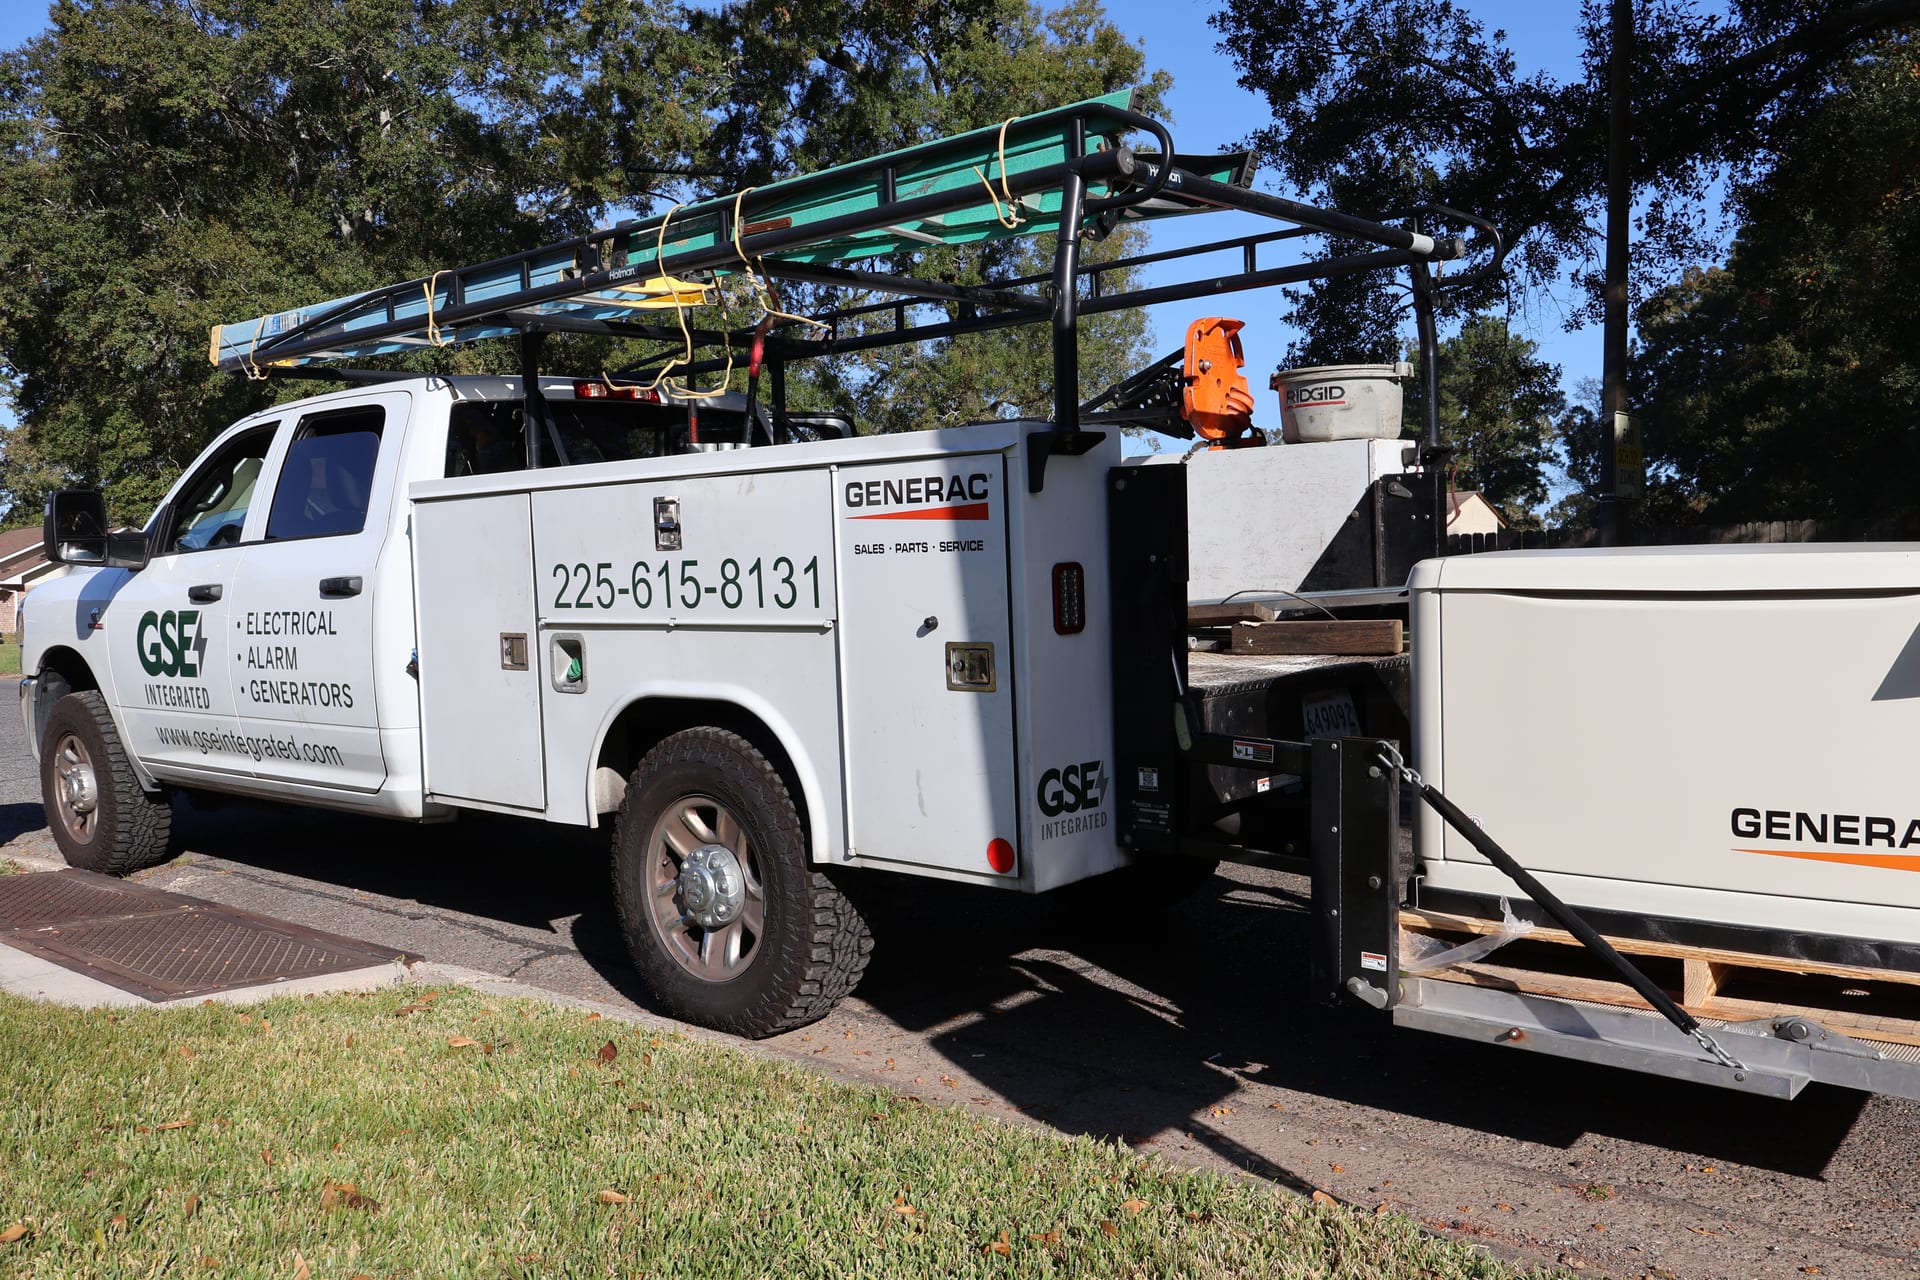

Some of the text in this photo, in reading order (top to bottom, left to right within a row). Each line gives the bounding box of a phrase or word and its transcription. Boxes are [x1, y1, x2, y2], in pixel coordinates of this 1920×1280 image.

[1148, 164, 1181, 184] Han
[609, 267, 636, 280] Holman
[1286, 386, 1346, 404] RIDGID
[845, 473, 989, 508] GENERAC
[854, 540, 984, 555] SALES PARTS SERVICE
[552, 555, 820, 609] 225-615-8131
[246, 611, 337, 636] ELECTRICAL
[137, 610, 200, 678] GSE
[247, 646, 298, 671] ALARM
[145, 684, 210, 710] INTEGRATED
[250, 680, 354, 709] GENERATORS
[155, 725, 345, 767] www.gseintegrated.com
[1038, 760, 1100, 817] GSE
[1041, 811, 1107, 840] INTEGRATED
